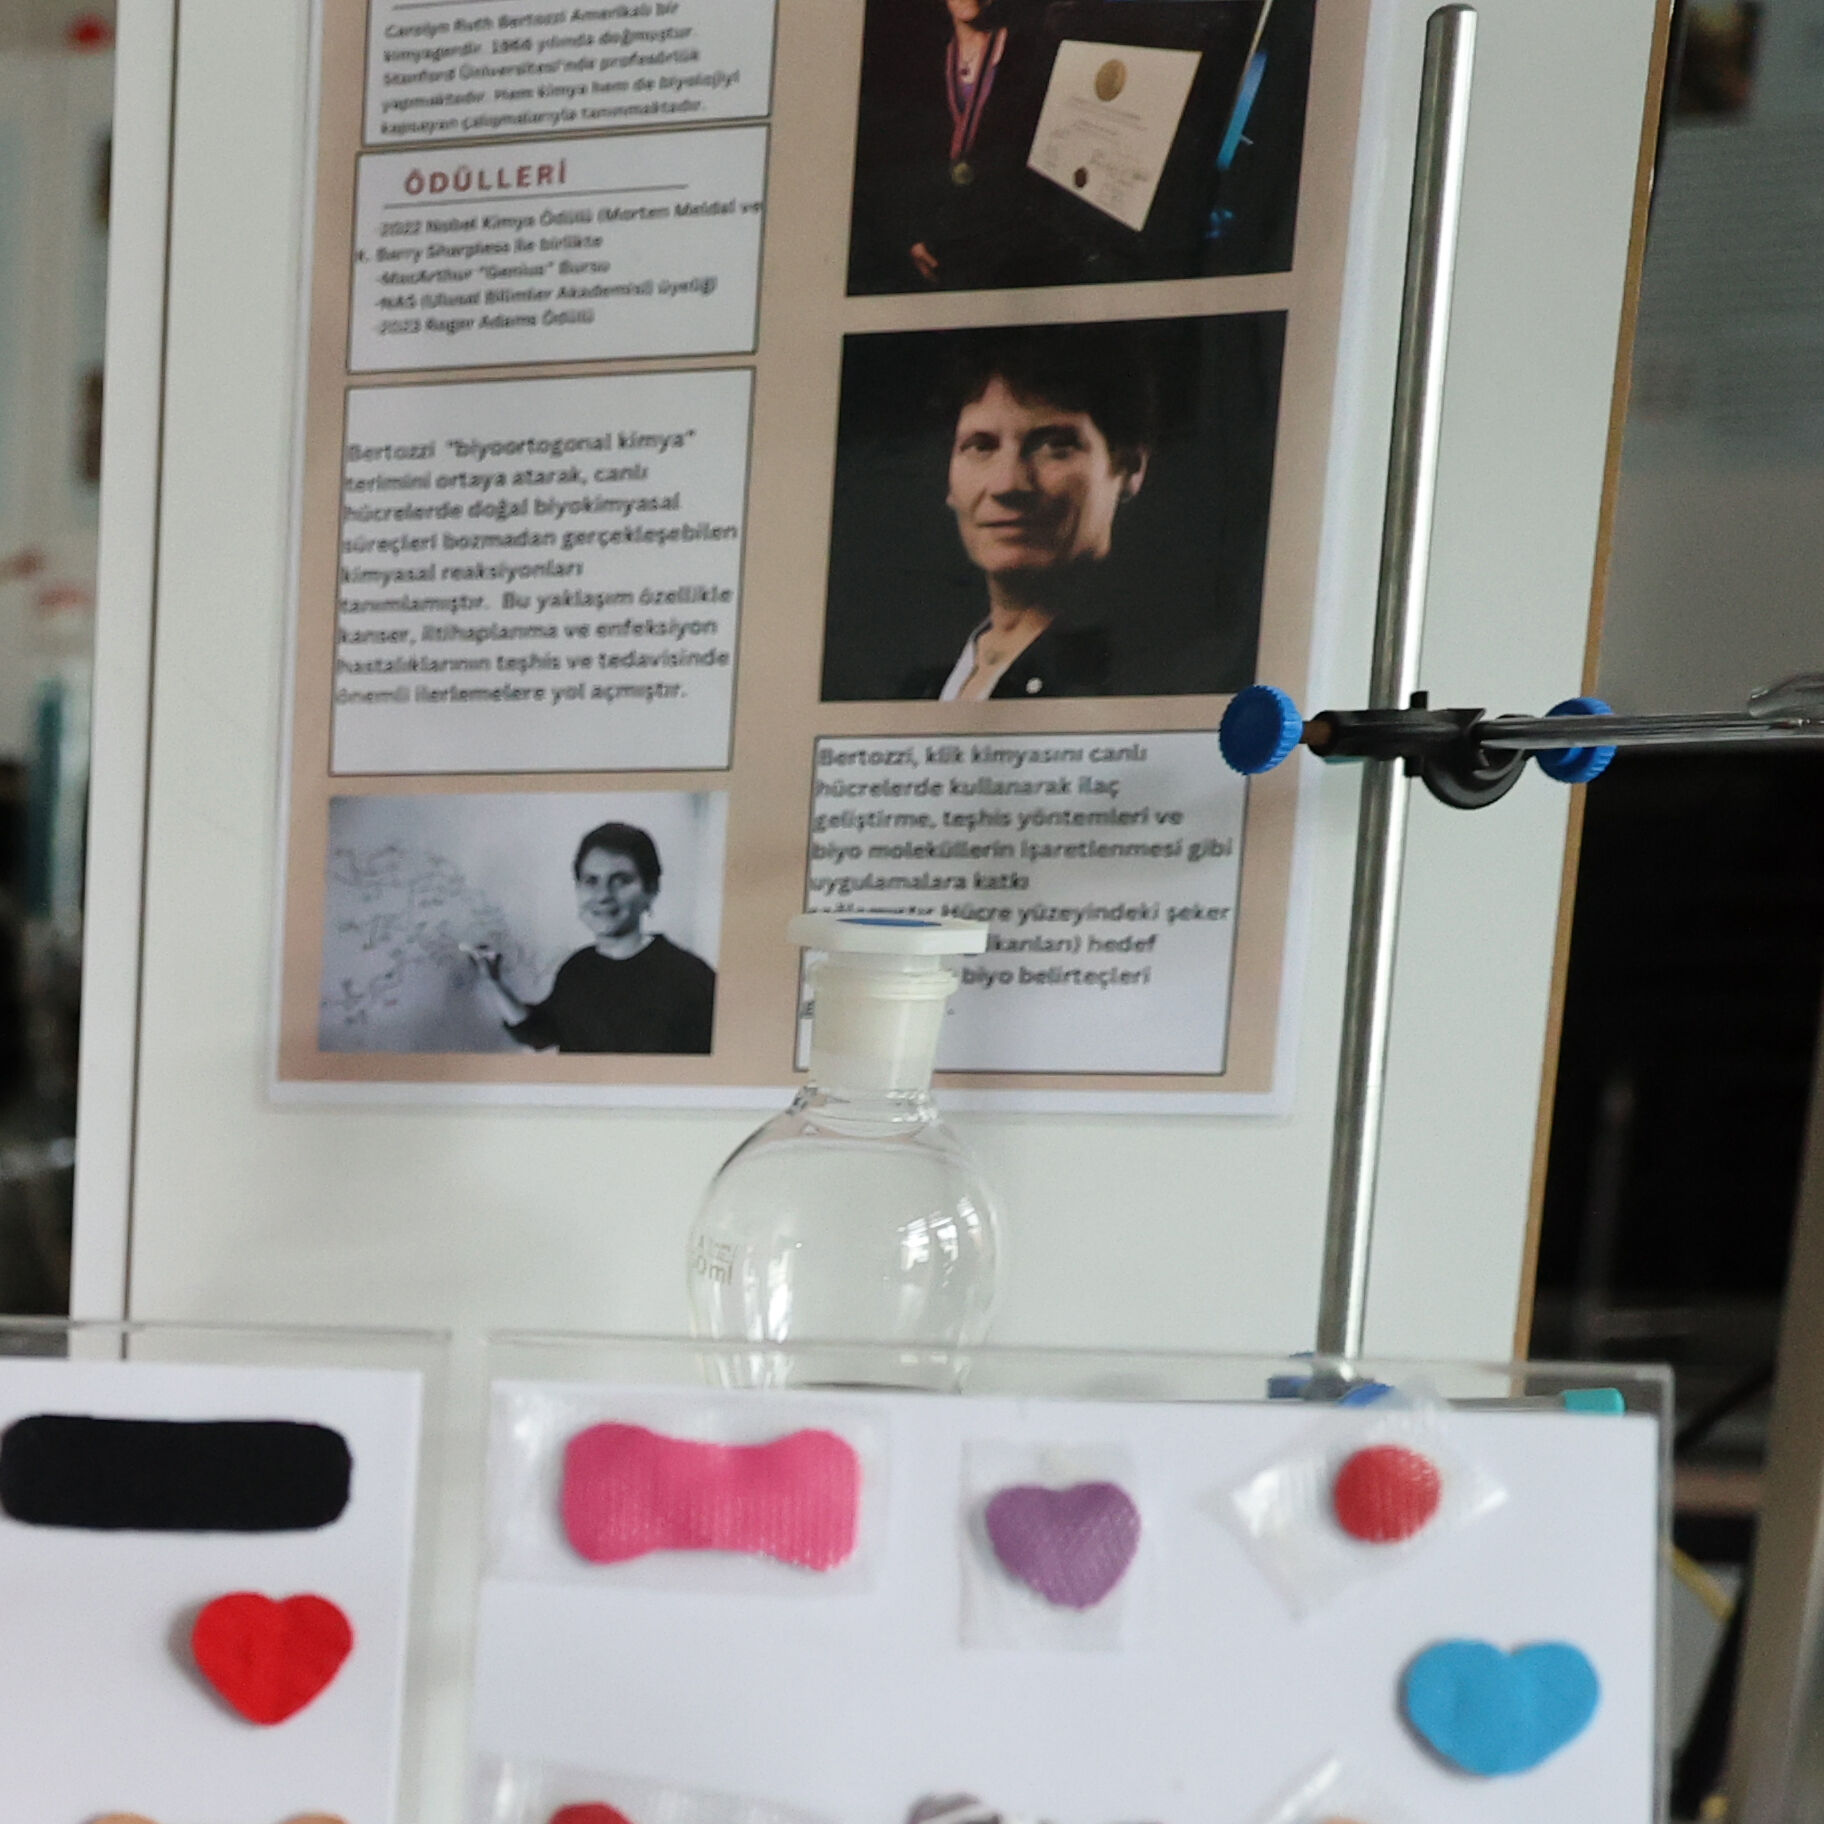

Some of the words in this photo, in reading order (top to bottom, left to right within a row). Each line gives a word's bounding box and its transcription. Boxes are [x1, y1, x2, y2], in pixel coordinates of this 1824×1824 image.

[404, 157, 567, 196] ÖDÜLLERİ
[345, 440, 437, 462] Bertozzi
[435, 472, 507, 493] ortaya
[593, 462, 650, 483] canlı
[343, 500, 464, 523] hücrelerde
[468, 497, 529, 523] doğal
[339, 562, 437, 588] kimyasal
[564, 623, 591, 639] ve
[565, 654, 593, 670] ve
[550, 681, 586, 707] yol
[1088, 743, 1148, 764] canlı
[814, 776, 944, 798] hücrelerde
[942, 807, 1013, 833] teşhis
[1155, 810, 1185, 826] ve
[1086, 932, 1160, 954] hedef
[961, 965, 1015, 990] biyo
